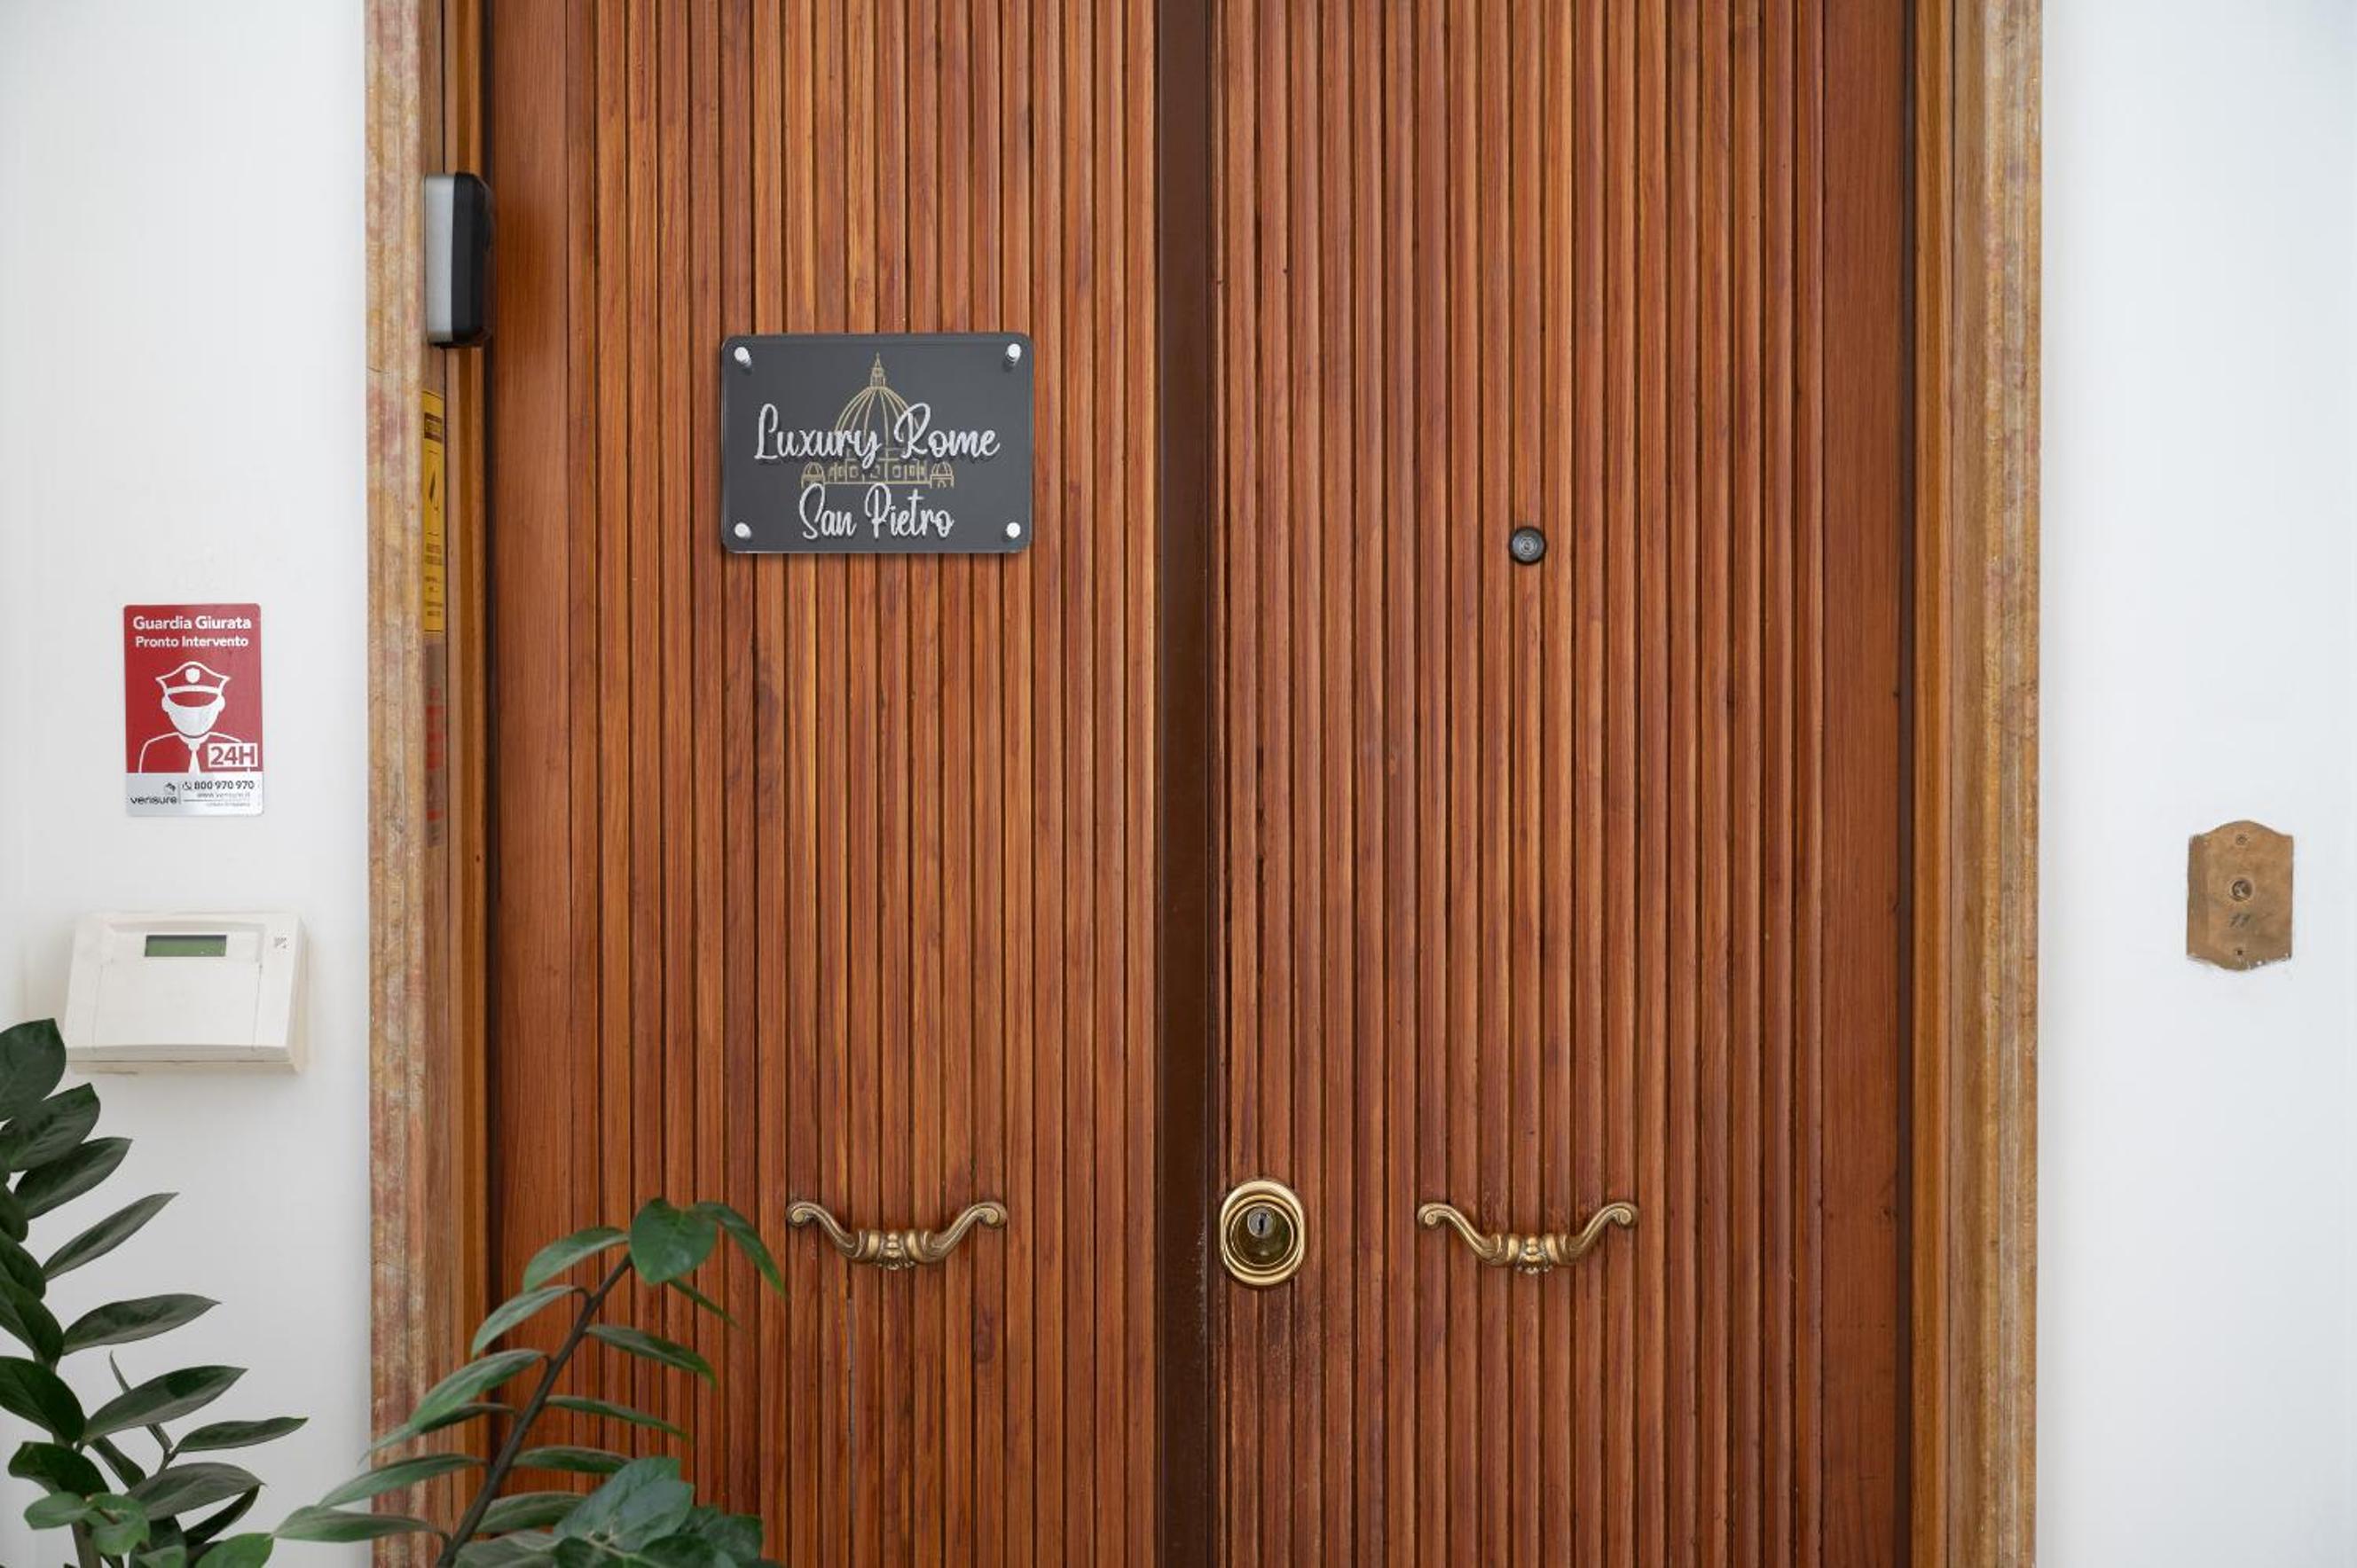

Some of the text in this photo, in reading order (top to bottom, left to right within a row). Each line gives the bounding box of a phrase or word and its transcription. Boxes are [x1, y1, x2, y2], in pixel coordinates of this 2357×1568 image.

[754, 403, 1001, 469] Luxury Rome
[799, 482, 955, 540] San Pietro
[133, 615, 252, 630] Guardia Giurata
[135, 636, 249, 647] Pronto Intervento
[210, 746, 255, 765] 24H
[193, 780, 255, 789] 800 970 970
